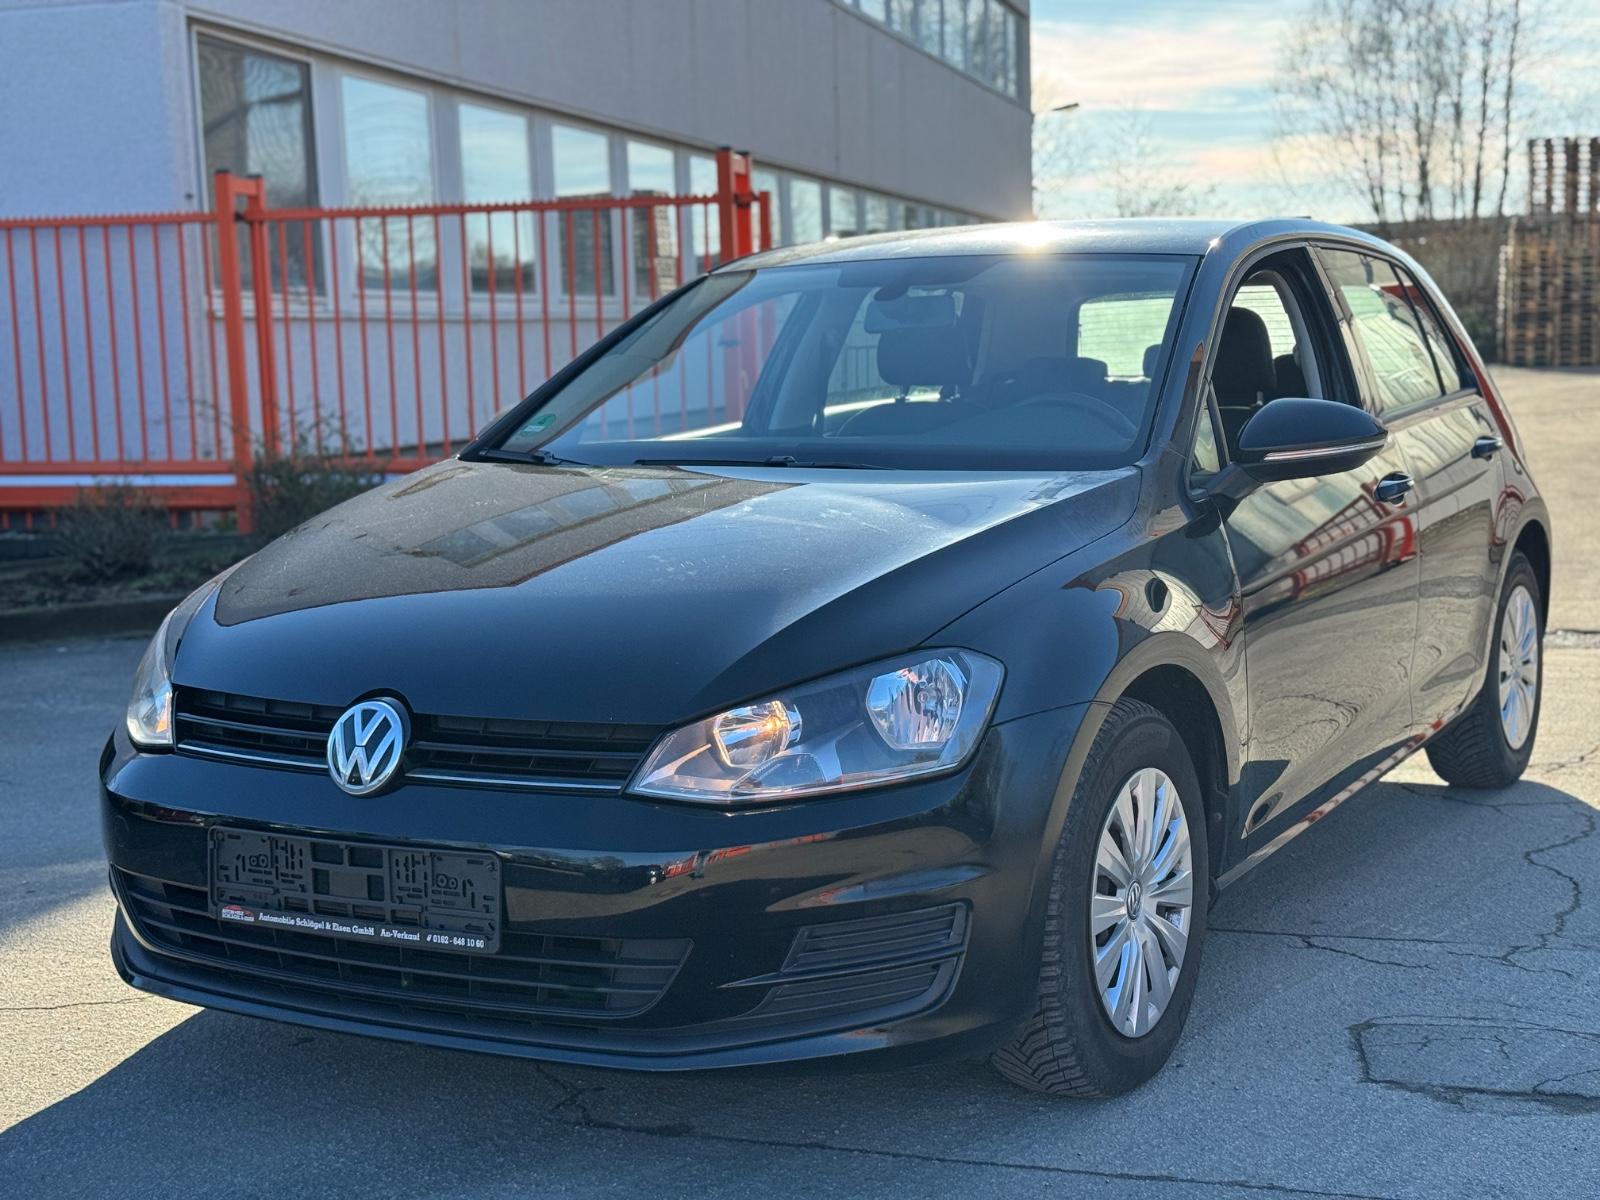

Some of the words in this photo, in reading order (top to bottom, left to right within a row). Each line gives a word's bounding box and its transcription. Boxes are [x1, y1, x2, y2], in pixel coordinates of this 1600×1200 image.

[330, 702, 400, 791] VW
[259, 912, 295, 925] Automobile
[352, 925, 375, 936] GmbH
[467, 938, 475, 947] 10
[476, 939, 485, 949] 60
